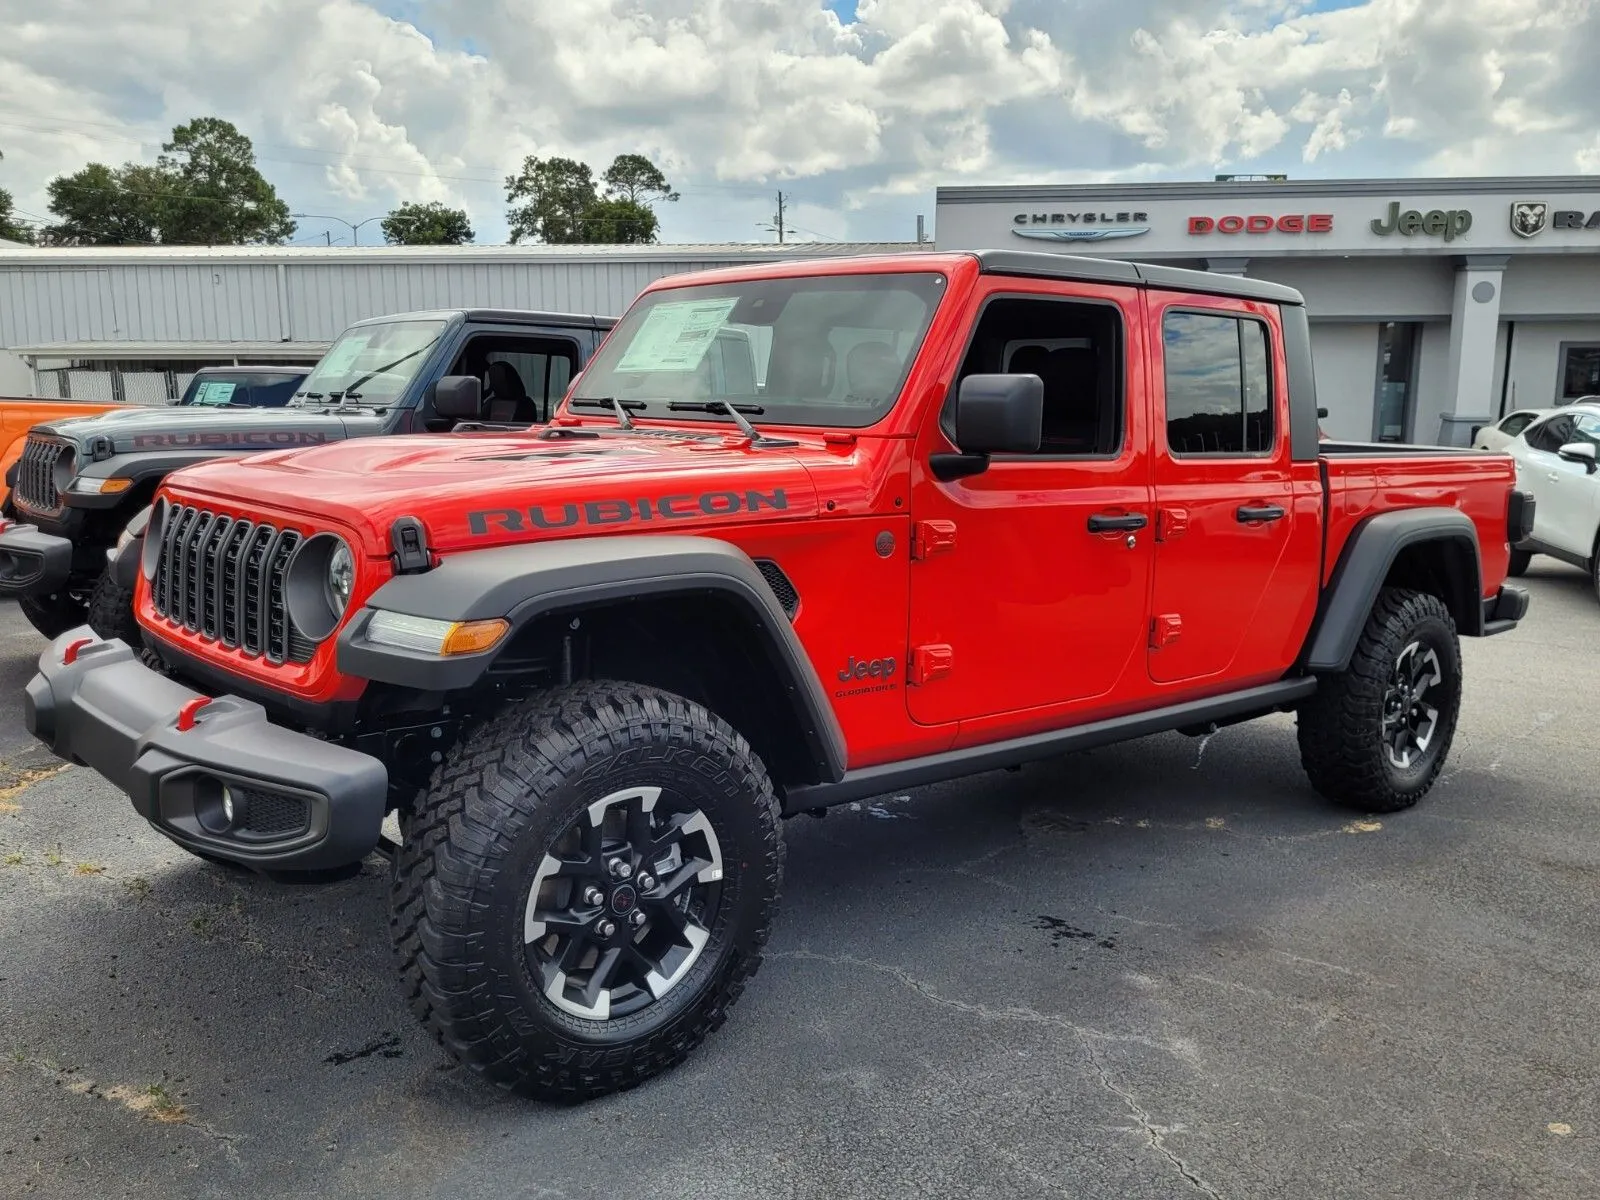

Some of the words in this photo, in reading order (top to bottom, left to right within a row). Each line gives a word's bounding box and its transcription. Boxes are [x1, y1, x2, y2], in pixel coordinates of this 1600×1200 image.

[1014, 212, 1148, 224] CHRYSLER
[1188, 215, 1334, 234] DODGE
[1371, 201, 1473, 242] Jeep
[133, 432, 326, 446] RUBICON
[467, 488, 789, 535] RUBICON
[838, 656, 896, 681] Jeep
